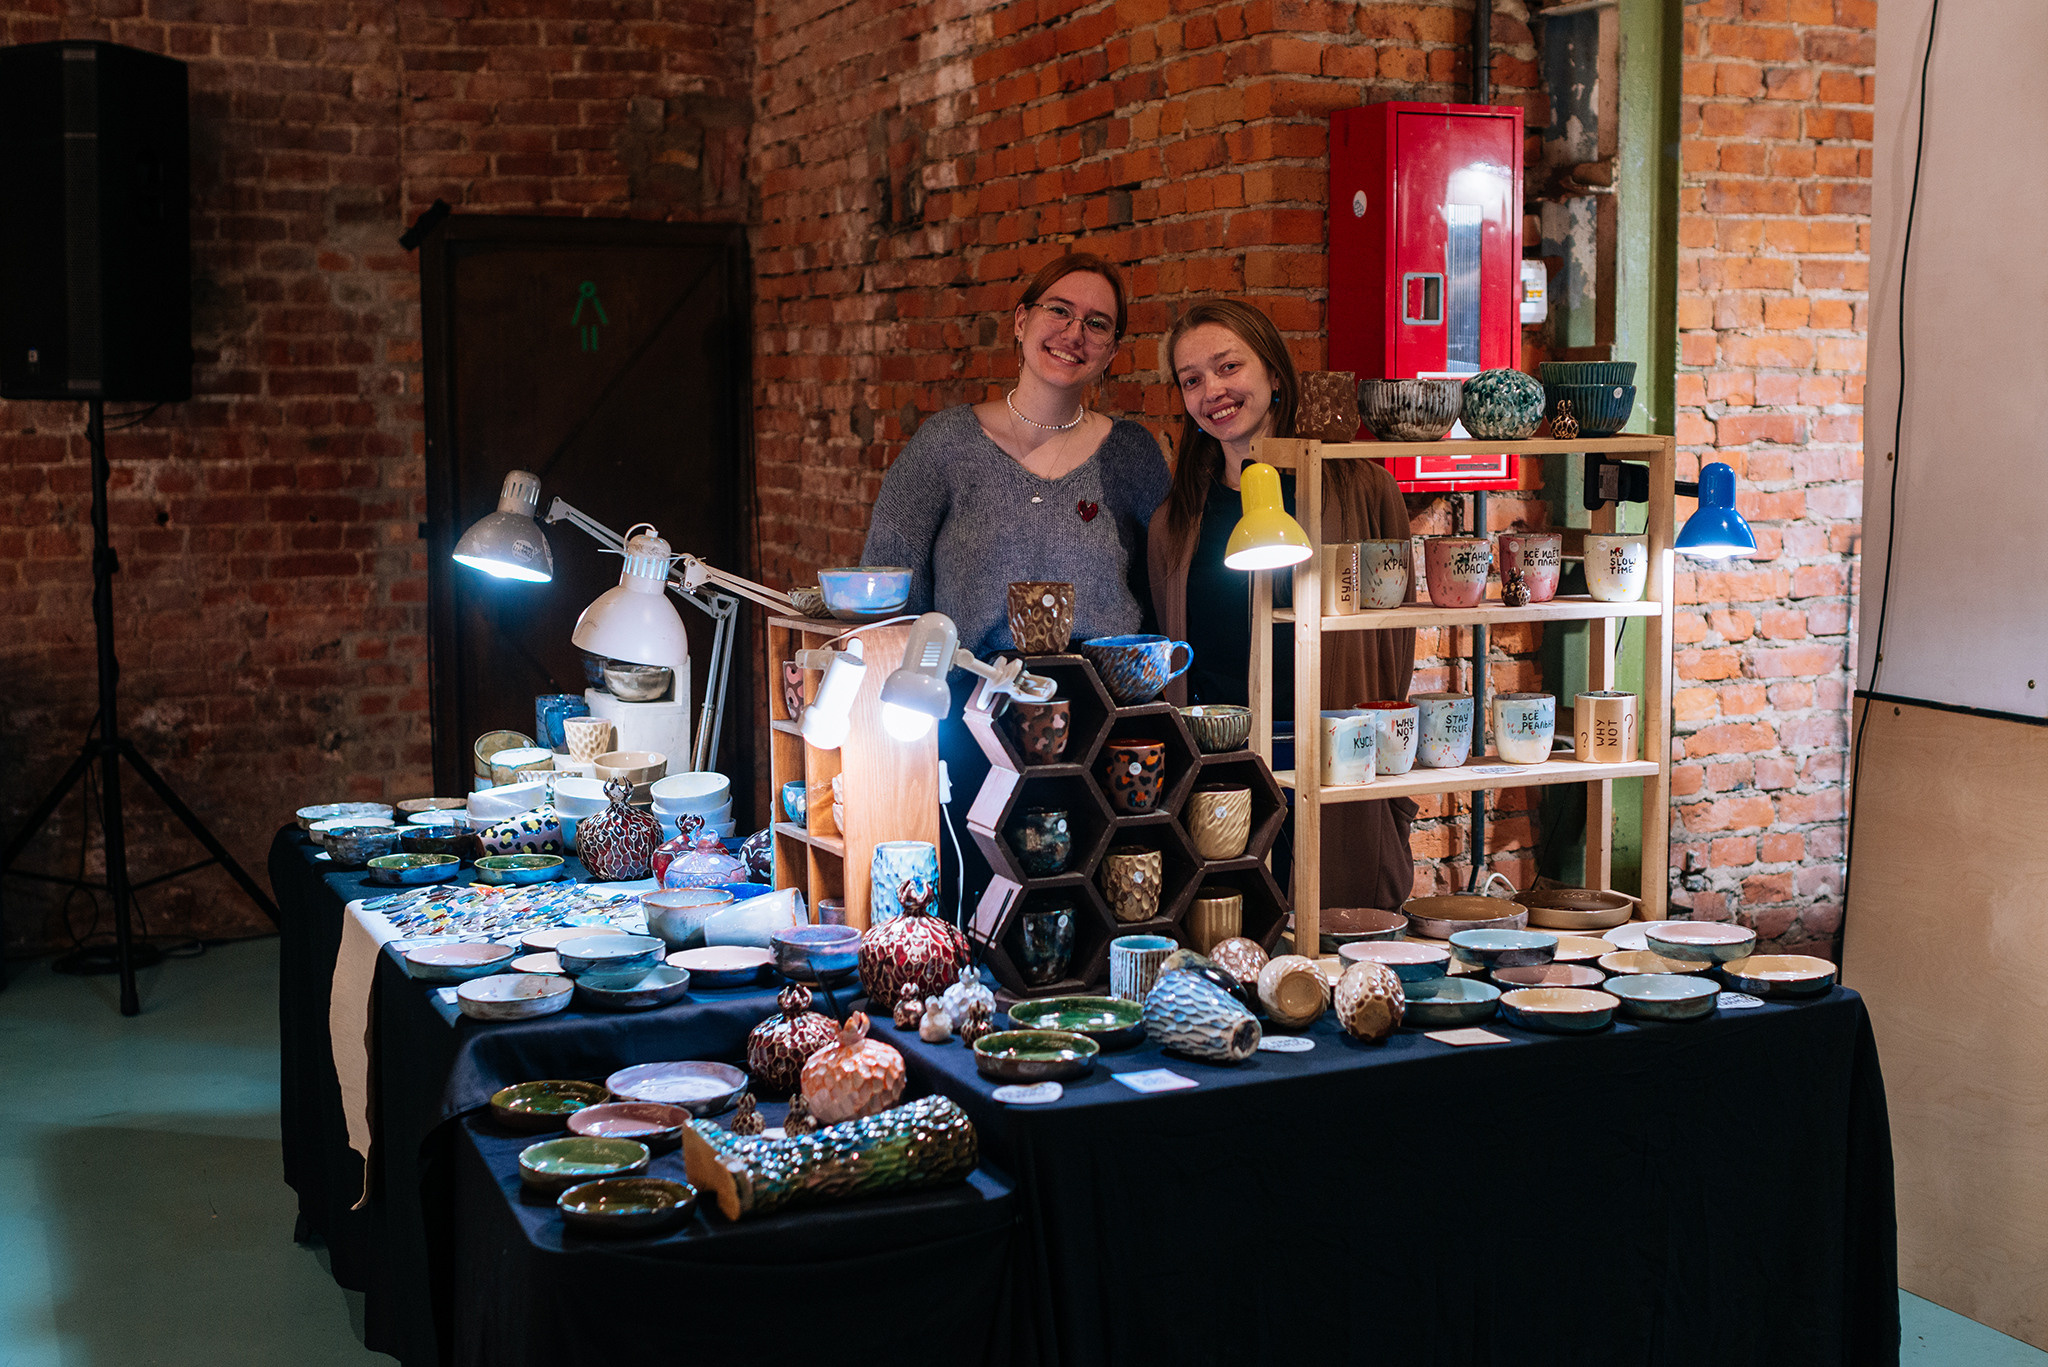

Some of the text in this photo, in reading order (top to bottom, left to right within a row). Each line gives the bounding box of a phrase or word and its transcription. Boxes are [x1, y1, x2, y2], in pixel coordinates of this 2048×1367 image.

[1524, 547, 1559, 559] ВСЁ ИДЁТ
[1610, 558, 1636, 566] SLOW
[1341, 567, 1352, 602] БУДЬ
[1445, 713, 1469, 725] STAY
[1522, 710, 1539, 721] ВСЁ
[1396, 717, 1414, 728] WHY
[1445, 724, 1468, 733] TRUE
[1624, 713, 1634, 740] ?
[1396, 727, 1414, 737] NOT
[1596, 719, 1605, 747] WHY
[1608, 720, 1618, 746] NOT
[1403, 736, 1410, 750] ?
[1581, 731, 1589, 748] ?
